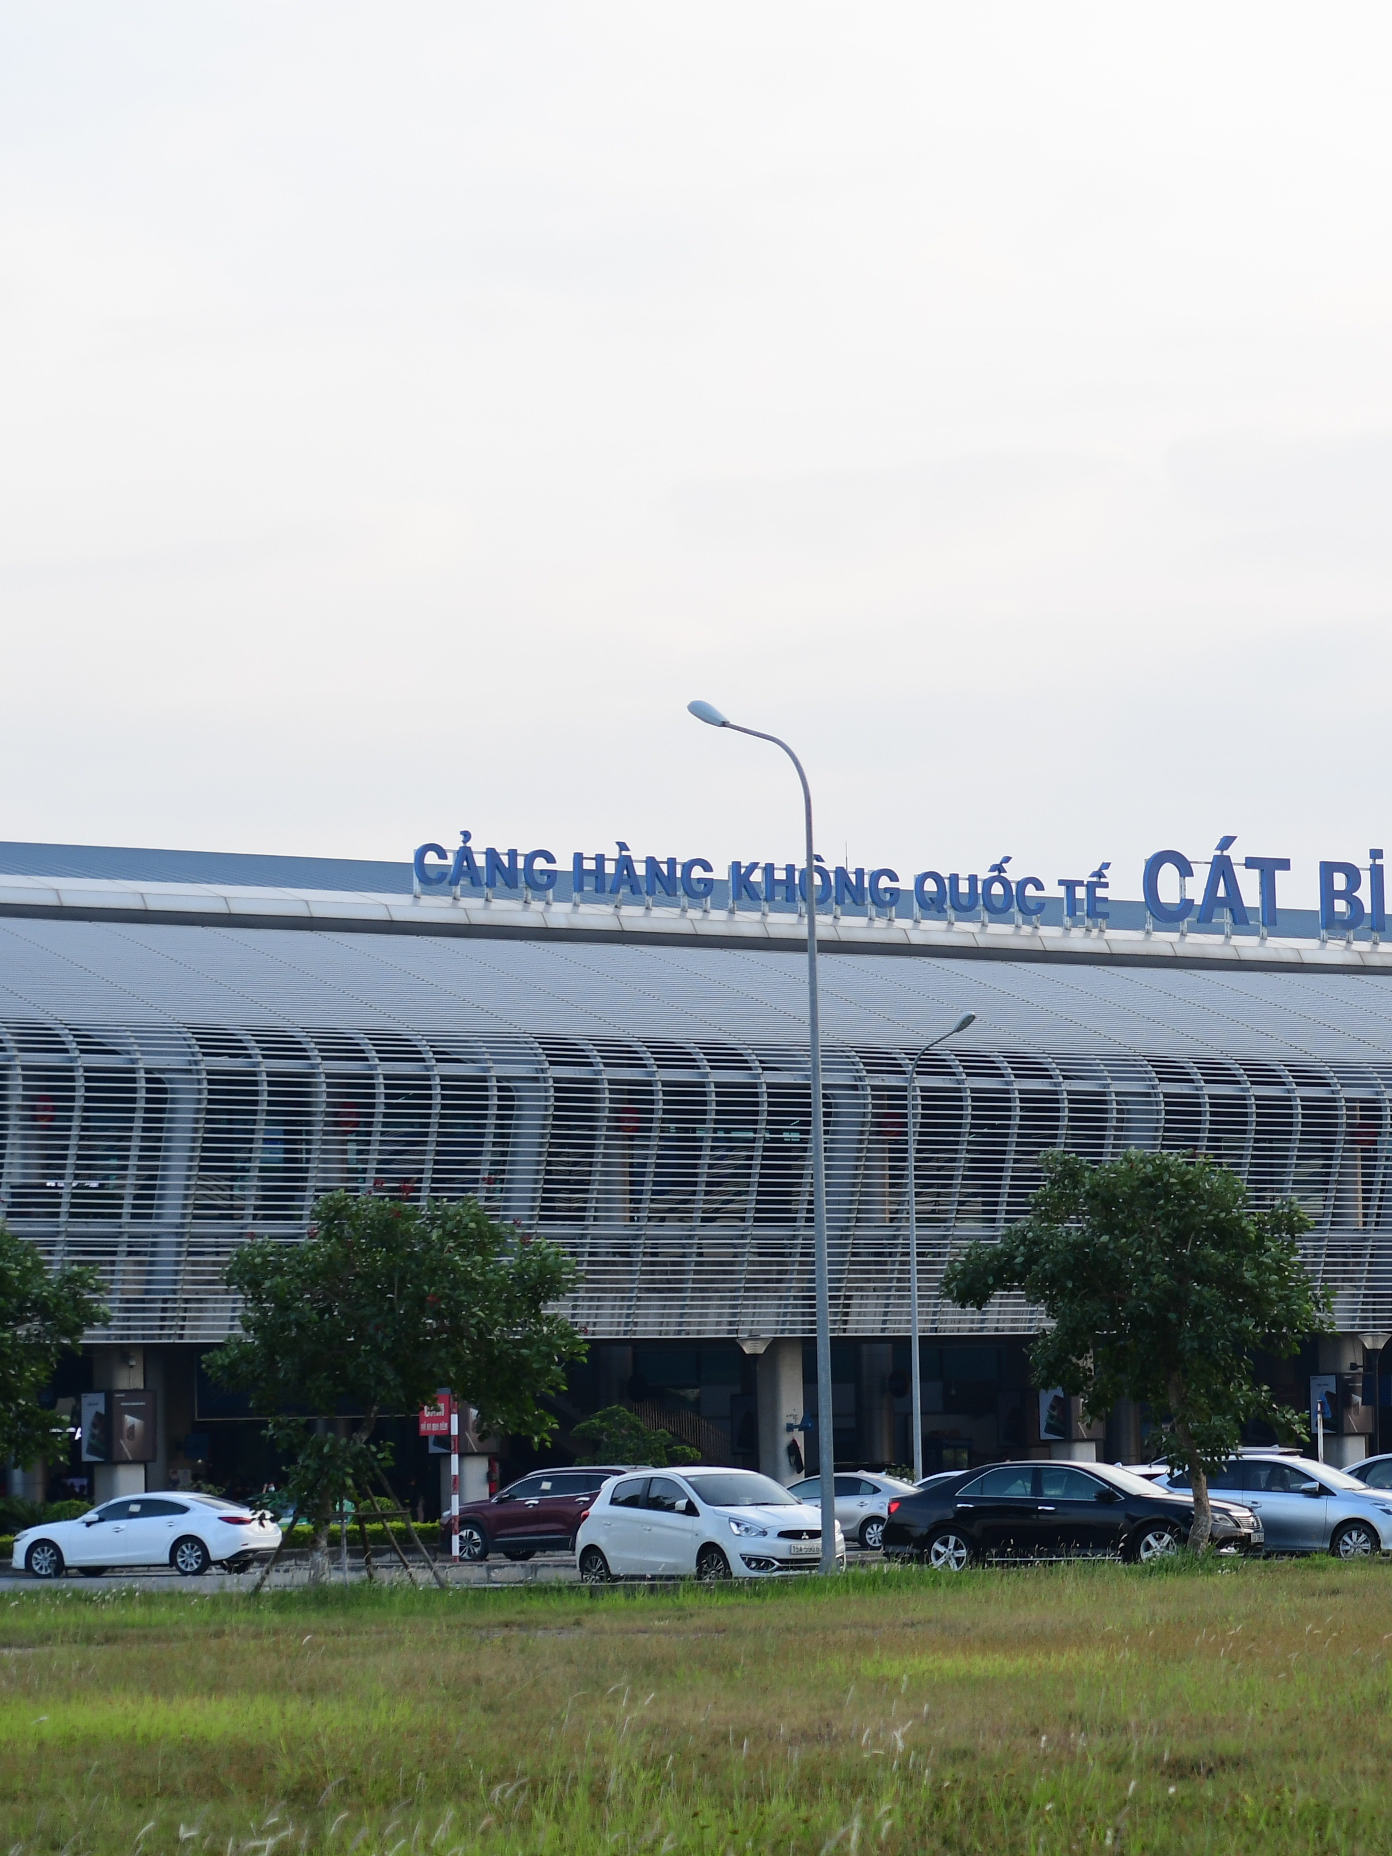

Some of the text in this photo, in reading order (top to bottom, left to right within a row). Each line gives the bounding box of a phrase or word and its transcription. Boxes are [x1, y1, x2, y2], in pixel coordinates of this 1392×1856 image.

[414, 830, 557, 891] CẢNG
[572, 841, 714, 900] HÀNG
[914, 856, 1046, 916] QUỐC
[1058, 862, 1112, 919] TẾ
[1143, 836, 1291, 926] CÁT
